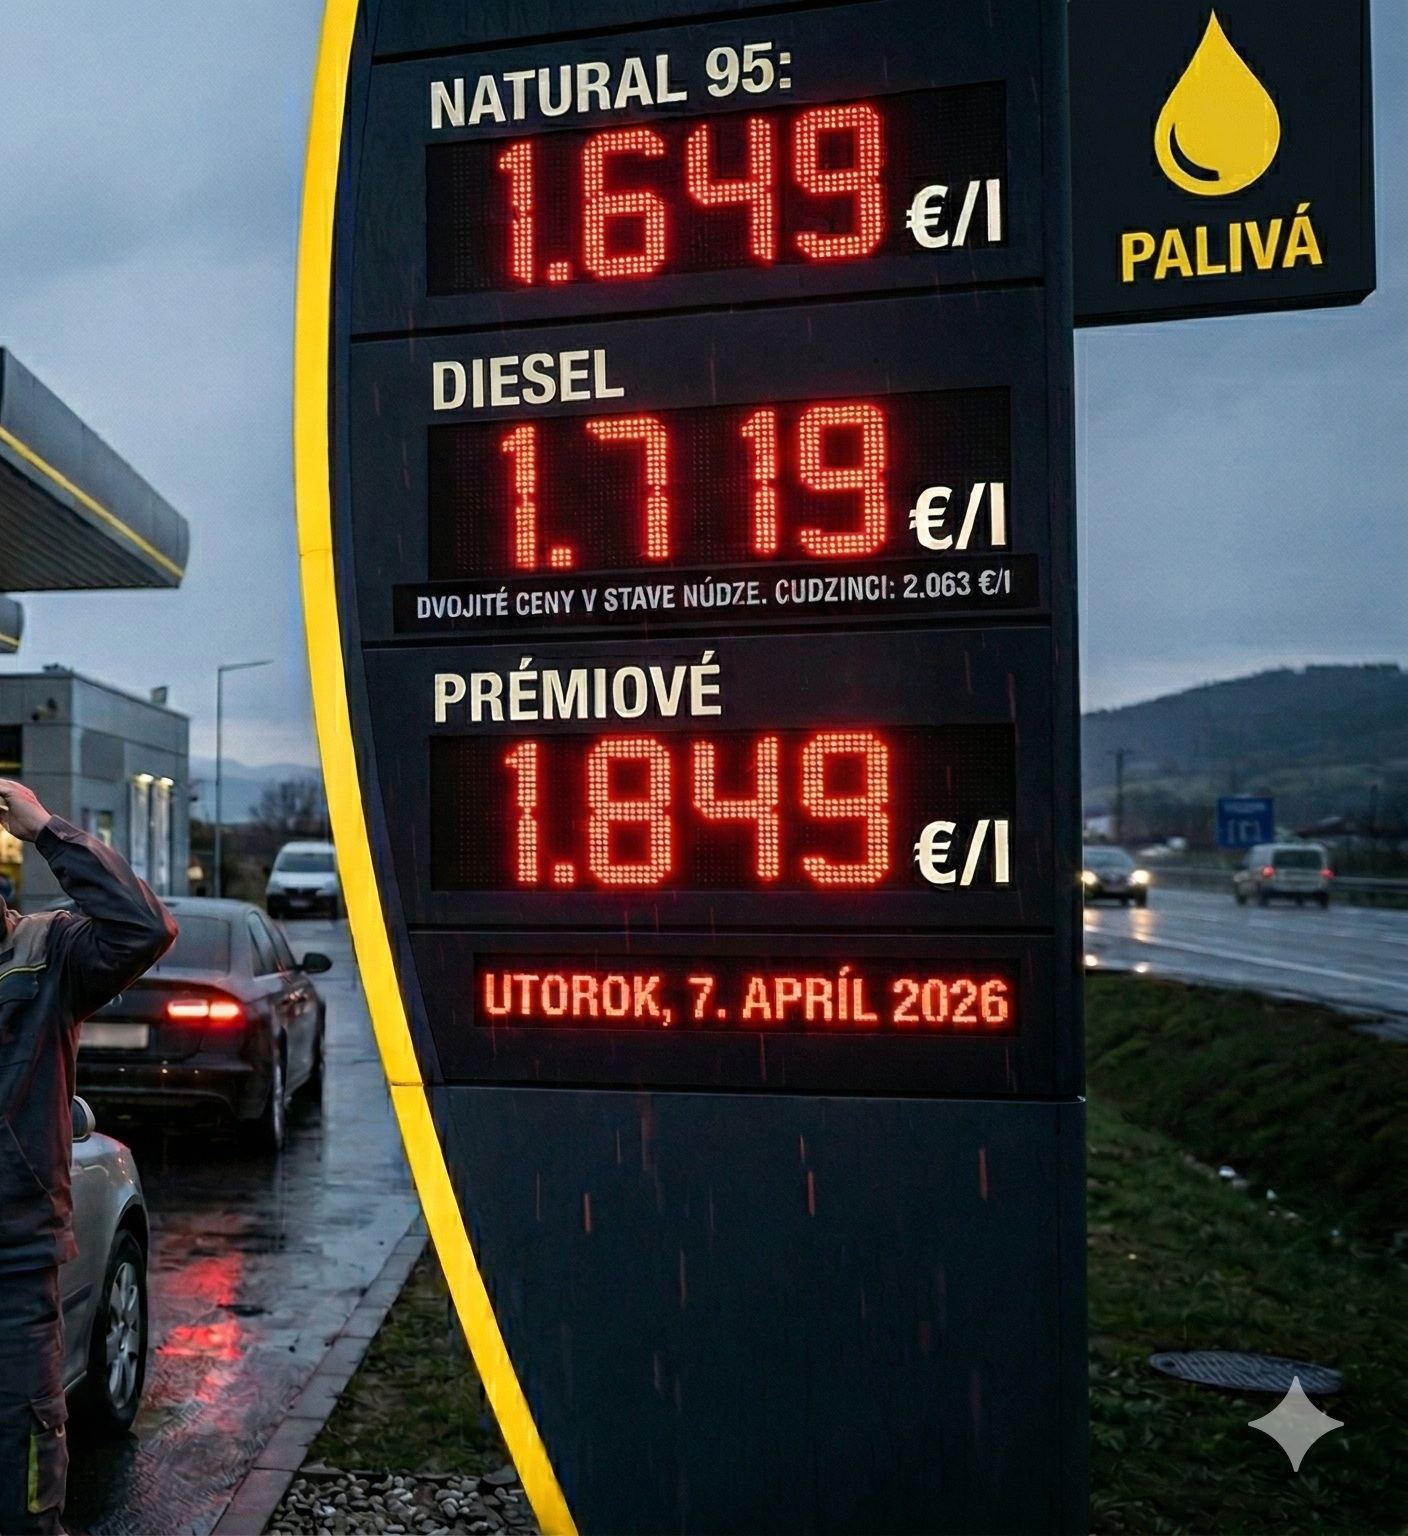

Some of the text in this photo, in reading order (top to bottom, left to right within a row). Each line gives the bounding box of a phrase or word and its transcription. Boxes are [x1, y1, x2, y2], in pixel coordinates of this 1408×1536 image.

[430, 41, 793, 130] NATURAL 95:
[497, 104, 885, 285] 1.649
[1121, 202, 1323, 283] PALIVÁ
[432, 349, 625, 411] DIESEL
[501, 404, 888, 570] 1.719
[417, 586, 509, 619] DVOJITÉ
[516, 589, 575, 616] CENY
[582, 588, 598, 613] V
[603, 585, 676, 612] STAVE
[683, 576, 767, 608] NÚDZE.
[775, 574, 896, 605] CUDZINCI:
[903, 571, 971, 599] 2.063
[434, 650, 723, 723] PRÉMIOVÉ
[504, 731, 890, 885] 1.849
[484, 965, 1010, 1027] UTOROK, 7. APRÍL 2026
